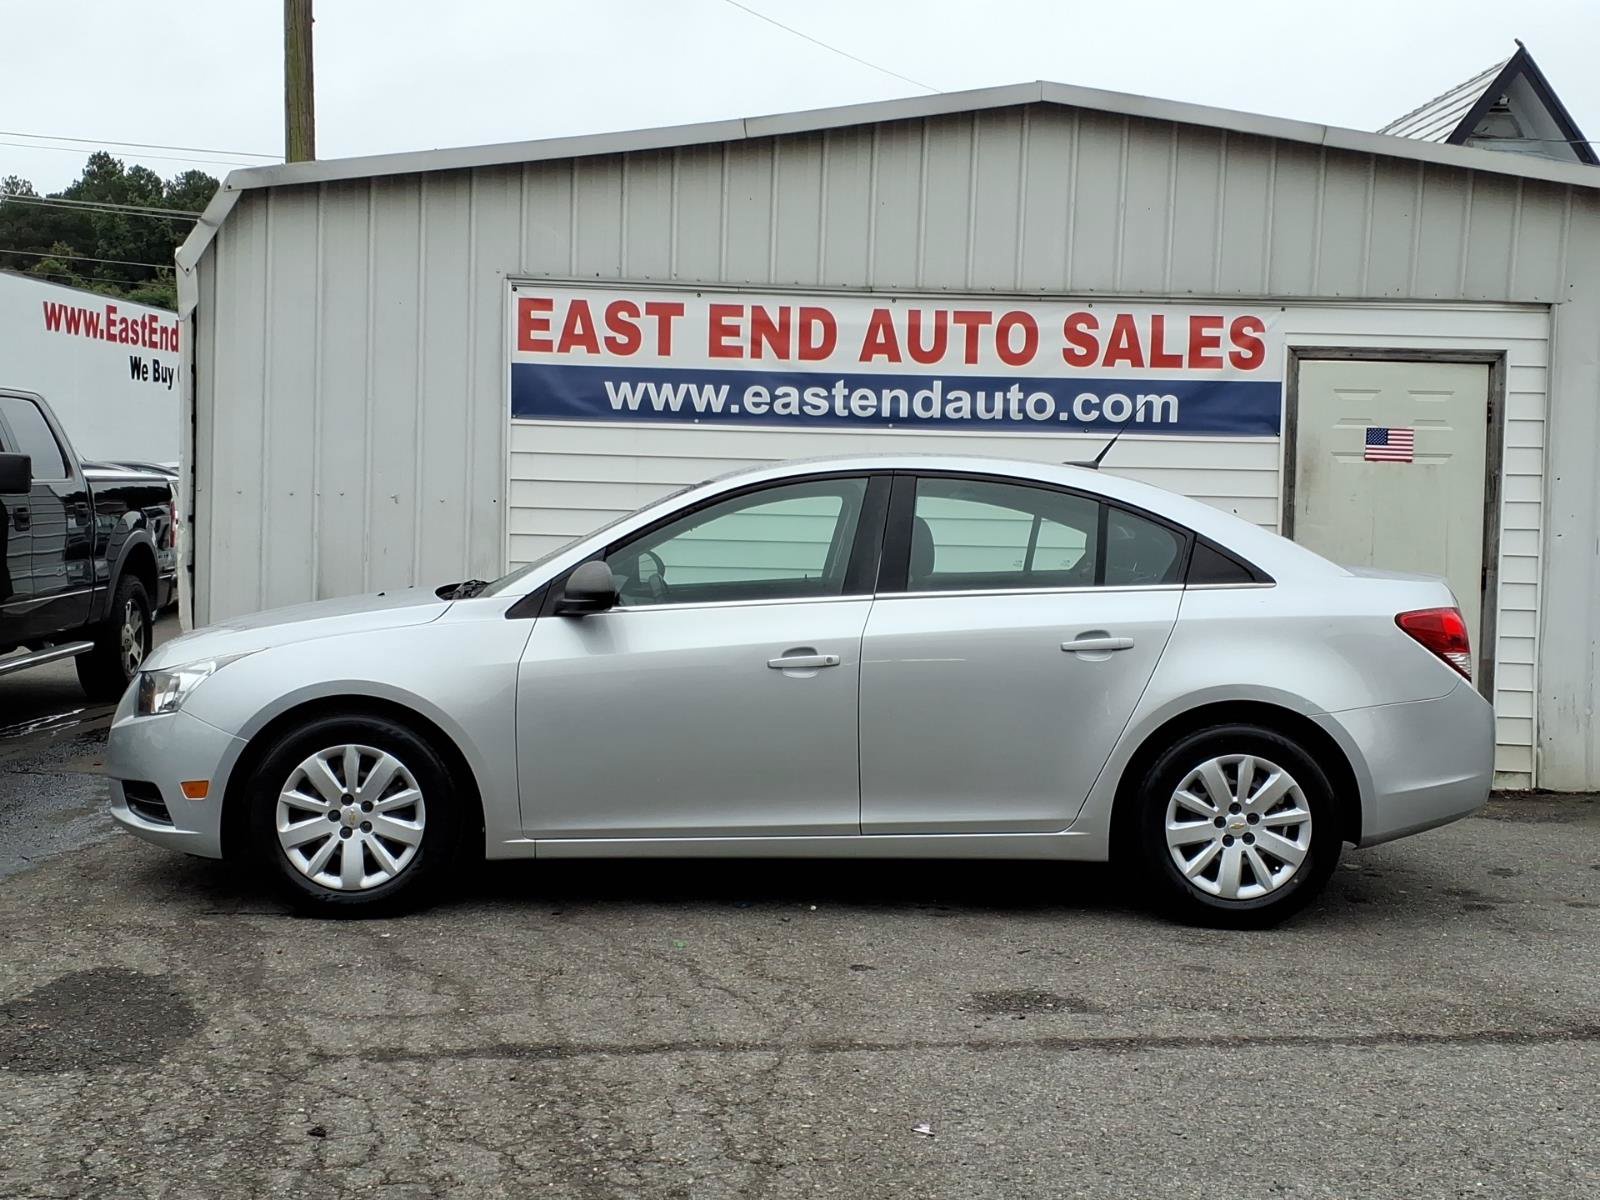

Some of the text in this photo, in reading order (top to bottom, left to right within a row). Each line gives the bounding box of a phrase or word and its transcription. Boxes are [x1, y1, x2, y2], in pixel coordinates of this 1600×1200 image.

[518, 297, 1266, 371] EAST END AUTO SALES
[129, 355, 149, 382] We
[152, 358, 175, 391] Buy
[604, 379, 1179, 424] www.eastendauto.com
